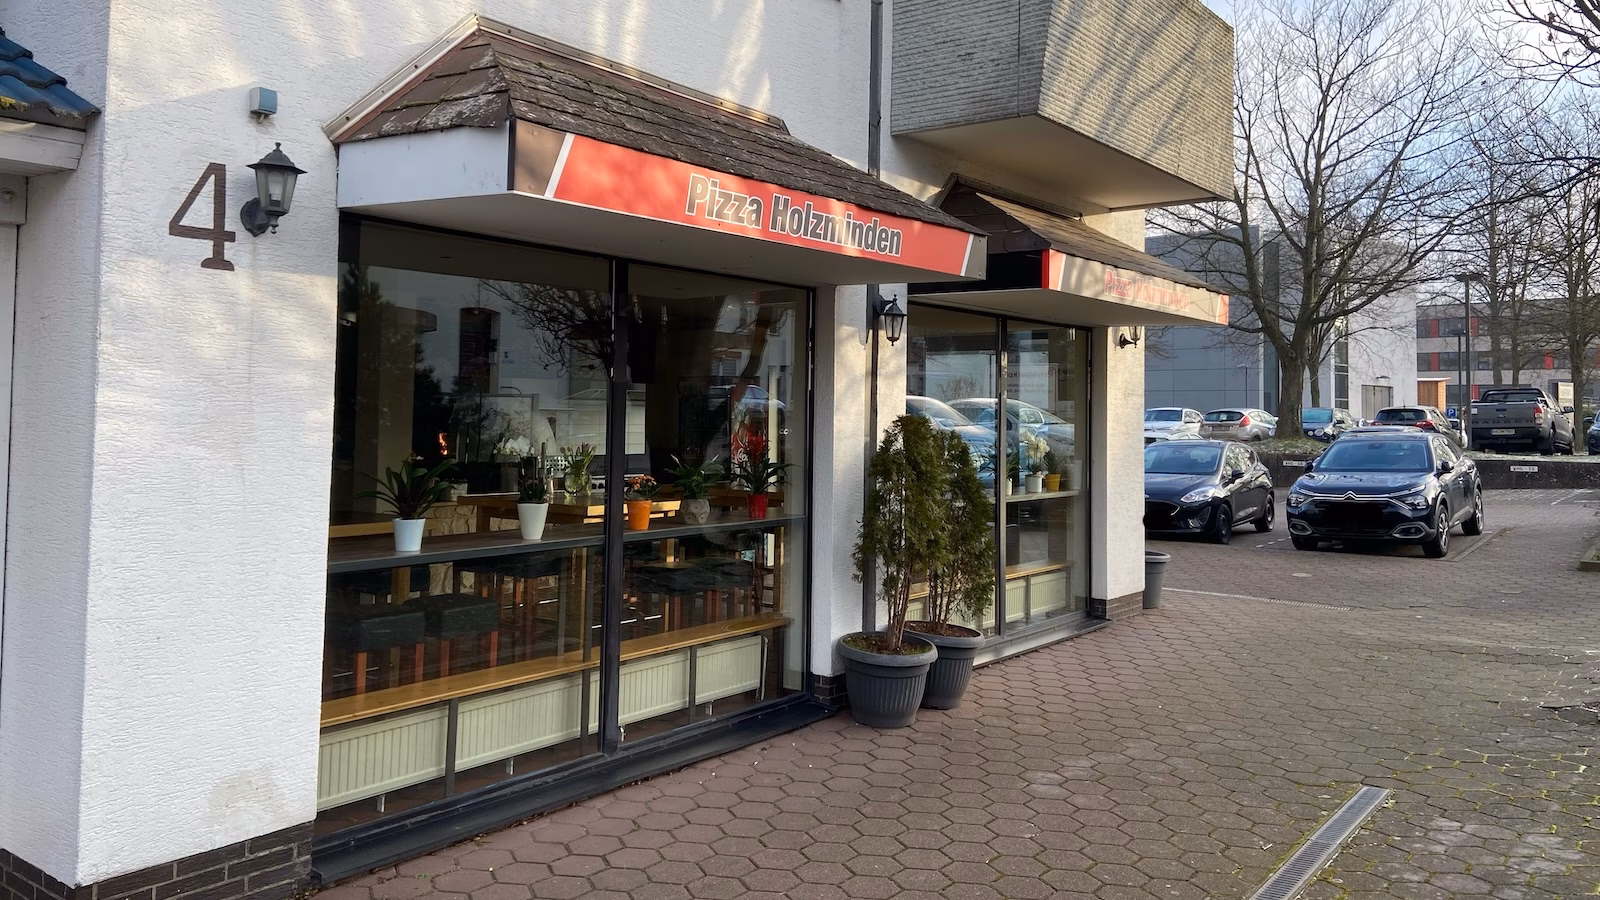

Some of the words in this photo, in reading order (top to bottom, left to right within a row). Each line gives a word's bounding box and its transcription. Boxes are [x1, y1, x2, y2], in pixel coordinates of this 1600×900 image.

[169, 162, 236, 271] 4
[685, 173, 764, 229] Pizza
[769, 193, 903, 257] Holzminden
[1103, 269, 1134, 300] Pizza
[1135, 276, 1191, 312] Holzminden
